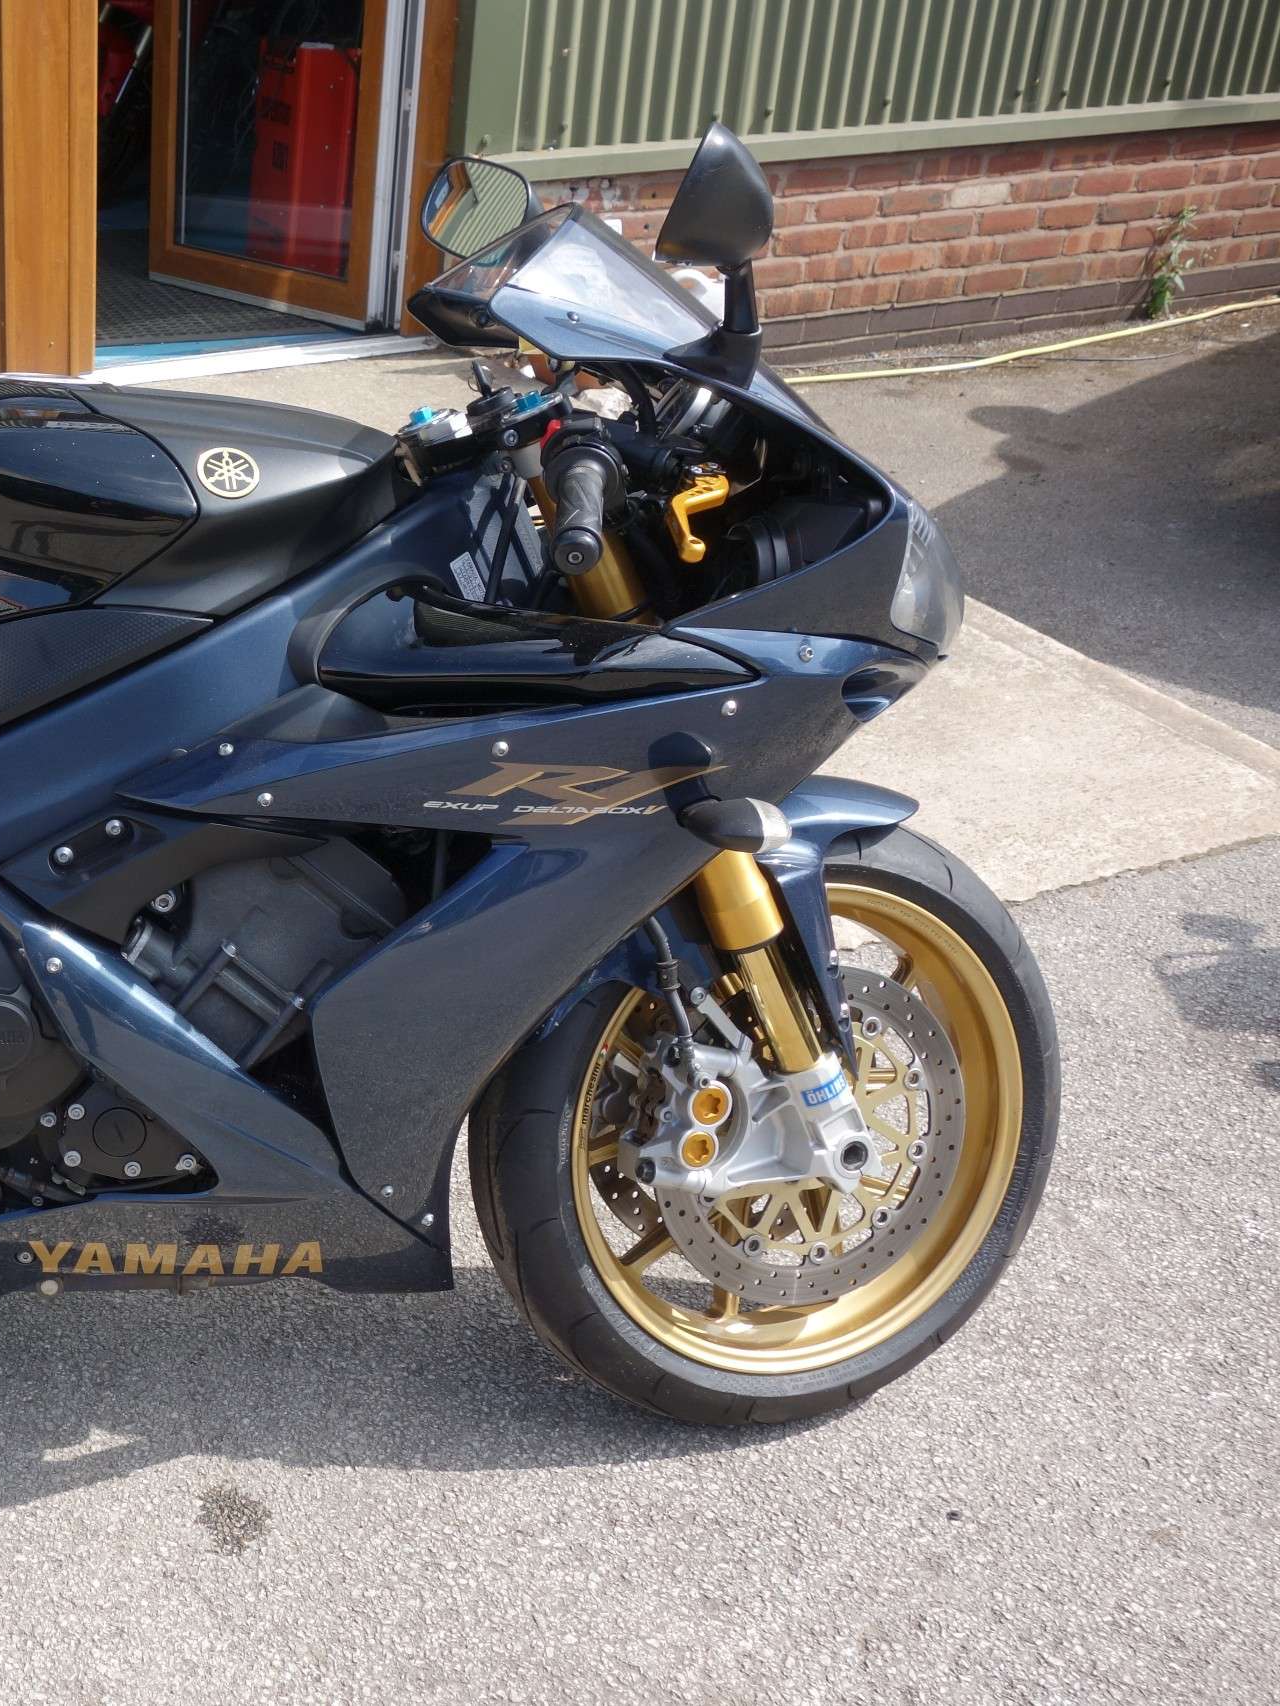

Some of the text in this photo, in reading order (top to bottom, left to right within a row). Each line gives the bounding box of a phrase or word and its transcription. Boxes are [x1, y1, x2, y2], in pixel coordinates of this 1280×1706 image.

[422, 799, 500, 812] EXUP
[580, 1062, 601, 1125] marchesini
[28, 1240, 324, 1276] YAMAHA
